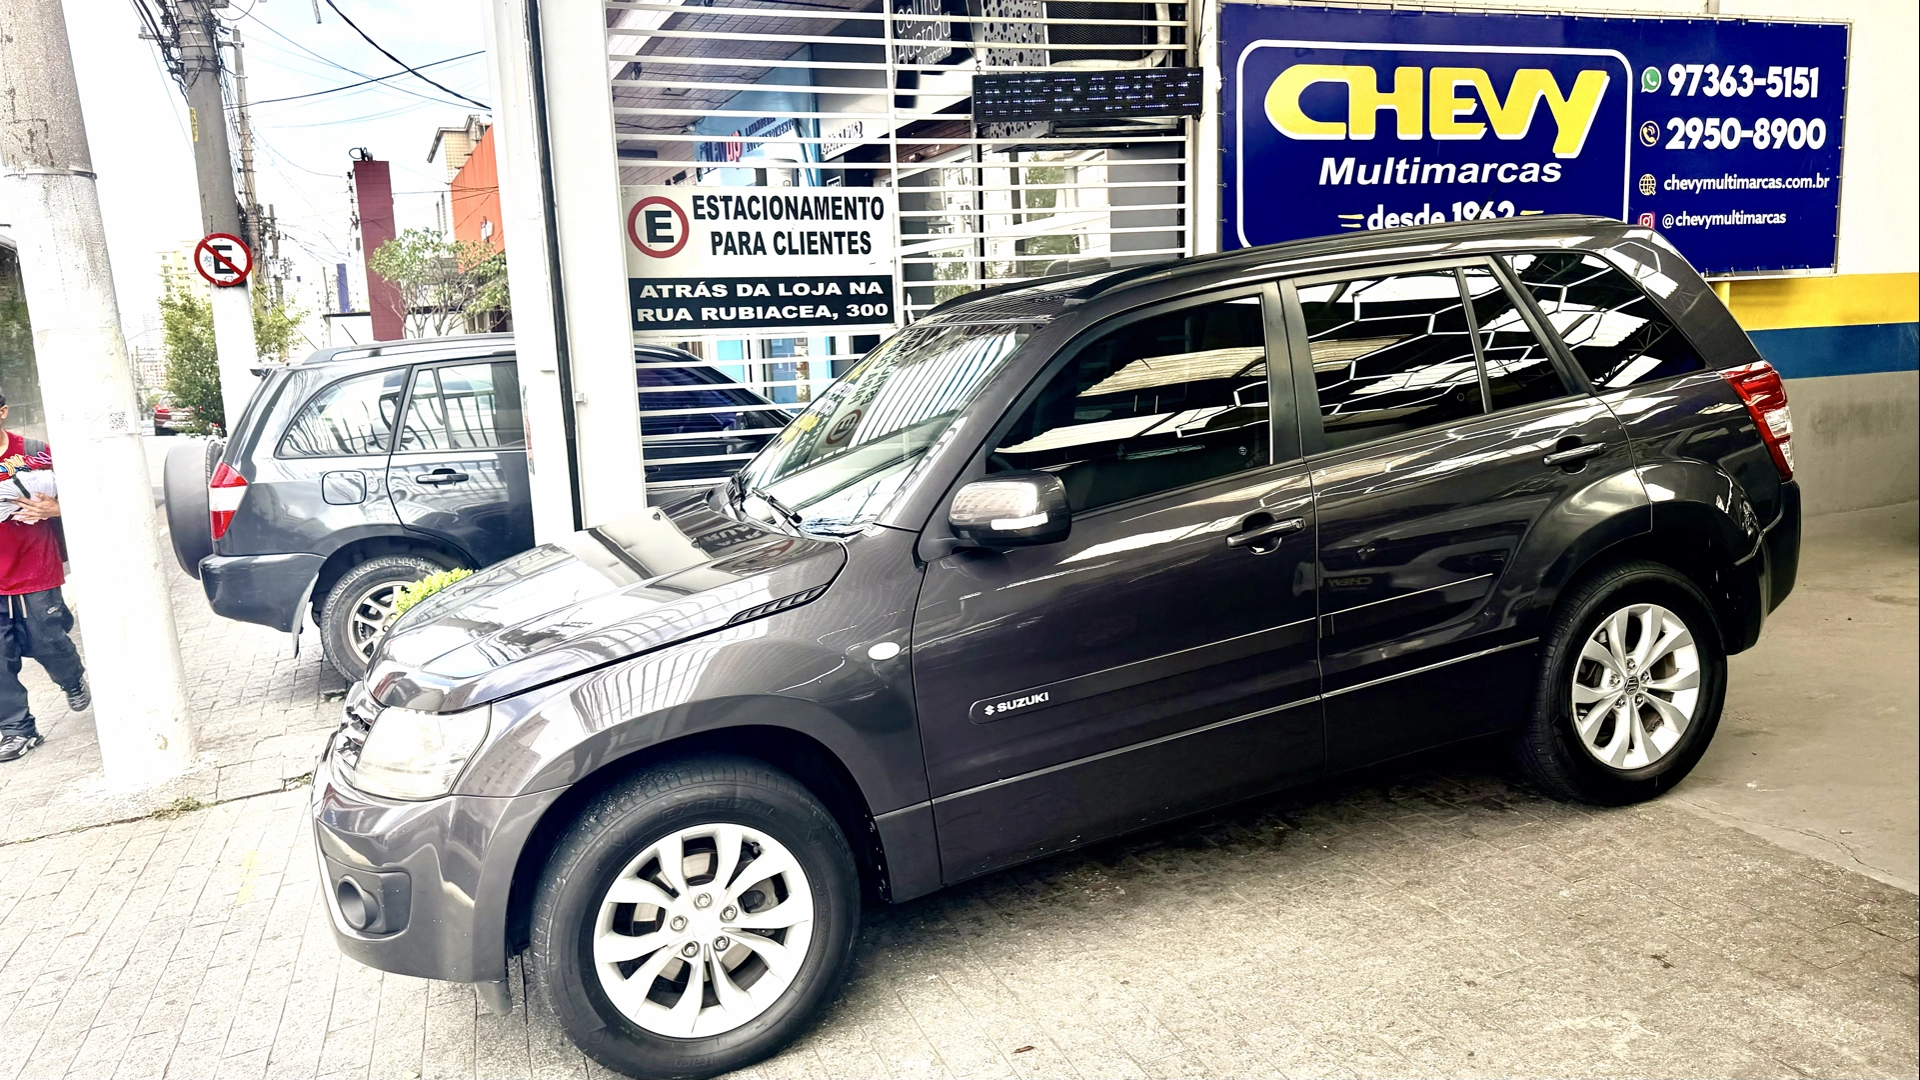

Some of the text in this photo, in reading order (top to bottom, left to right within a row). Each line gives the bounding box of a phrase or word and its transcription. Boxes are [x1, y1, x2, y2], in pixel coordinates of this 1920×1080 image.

[1667, 63, 1819, 98] 97363-5151
[1263, 63, 1609, 159] CHEVY
[1665, 117, 1827, 150] 2950-8900
[1318, 157, 1562, 185] Multimarcas
[1663, 173, 1830, 194] chevymultimarcas.com.br
[692, 194, 885, 221] ESTACIONAMENTO
[1367, 203, 1446, 230] desde
[645, 210, 674, 243] E
[711, 231, 872, 256] PARA CLIENTES
[212, 245, 235, 274] E
[639, 281, 884, 299] ATRÁS DA LOJA NA
[636, 303, 889, 322] RUA RUBIACEA, 300
[996, 691, 1049, 713] SUZUKI
